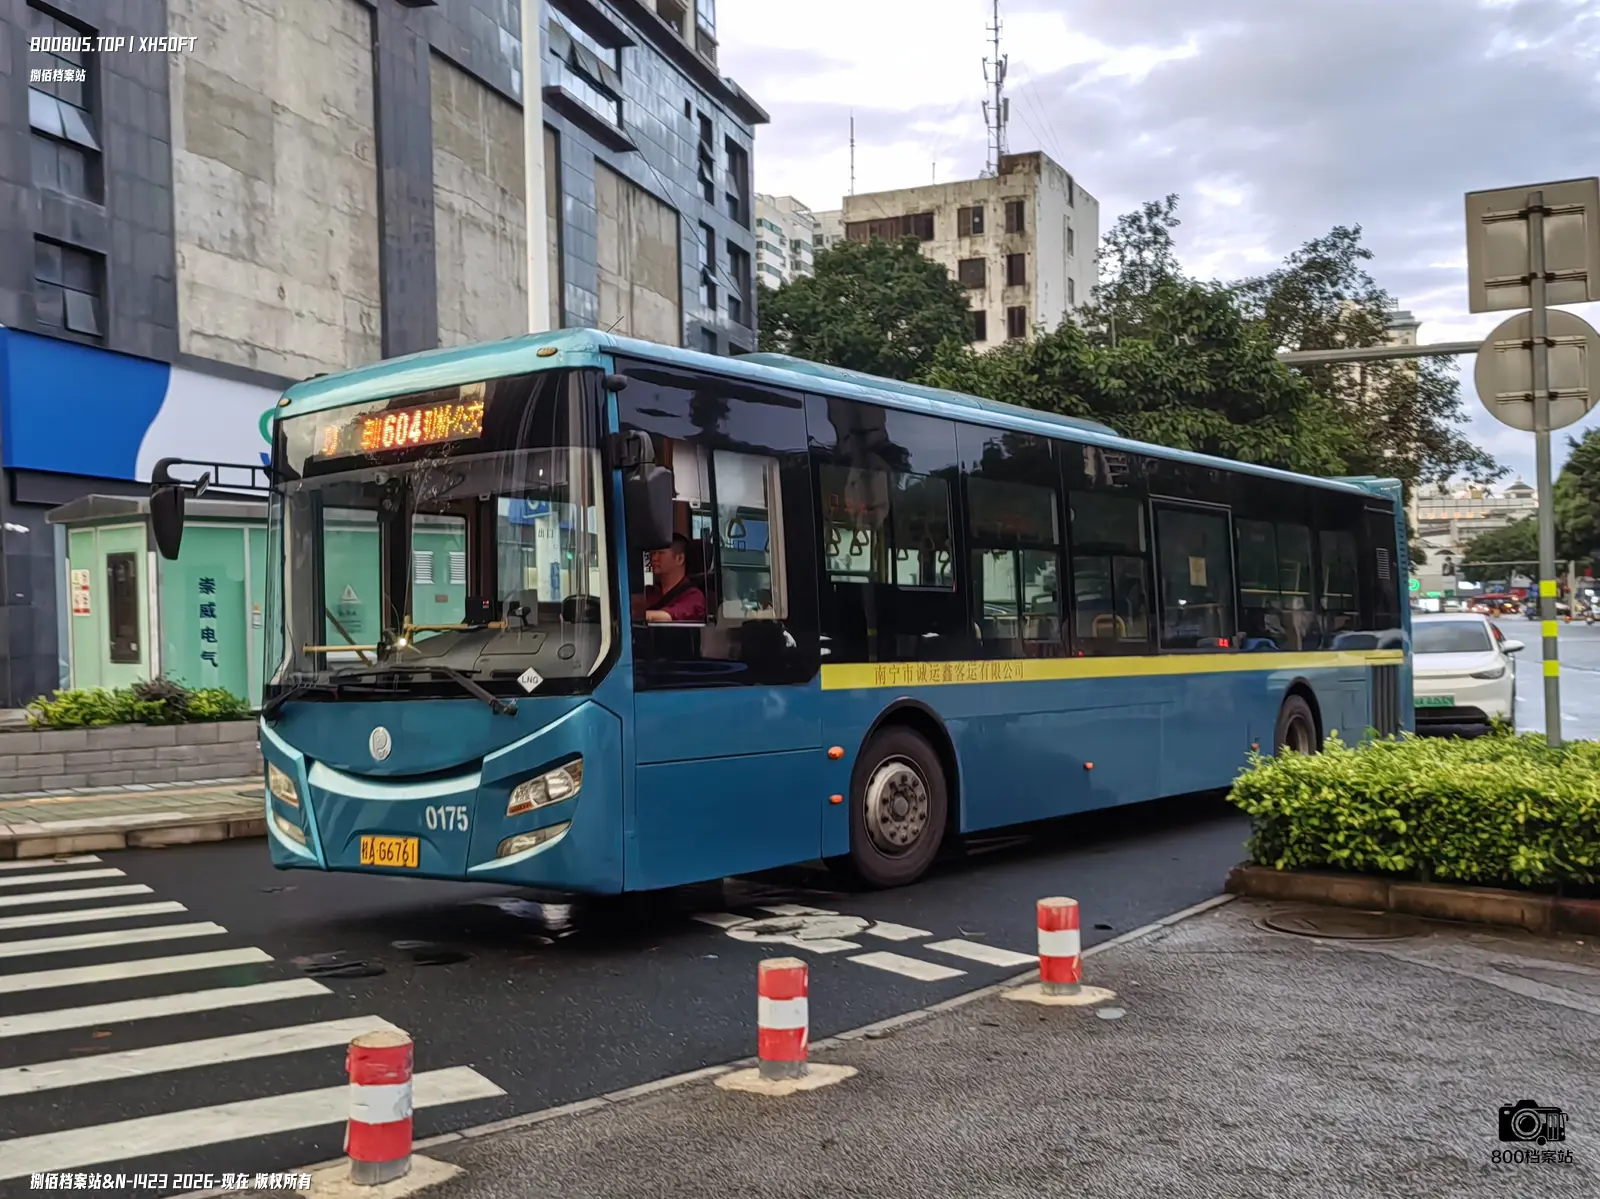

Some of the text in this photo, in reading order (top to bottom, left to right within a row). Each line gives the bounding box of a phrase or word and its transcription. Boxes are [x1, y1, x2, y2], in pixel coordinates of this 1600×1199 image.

[383, 409, 422, 449] 604
[874, 660, 1024, 686] 南宁市诚运鑫客运有限公司
[425, 805, 469, 832] 0175
